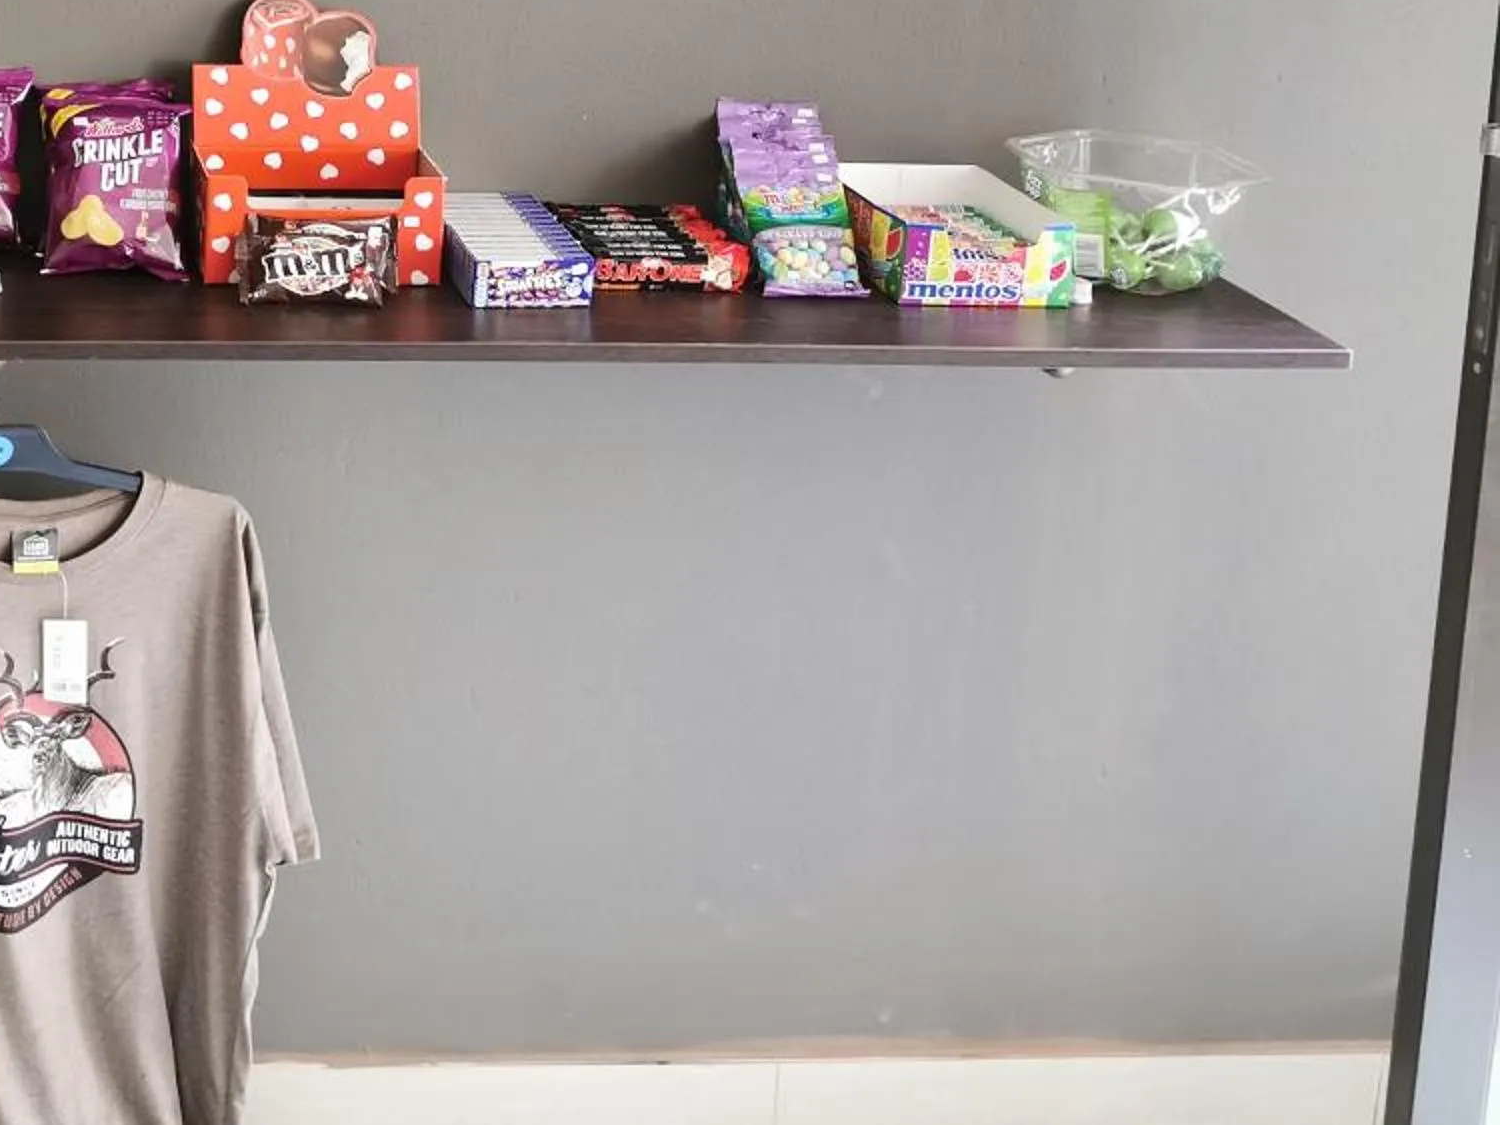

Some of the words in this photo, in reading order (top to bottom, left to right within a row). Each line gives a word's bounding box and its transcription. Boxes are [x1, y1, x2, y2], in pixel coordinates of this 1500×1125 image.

[71, 128, 165, 168] CRINKLE
[100, 158, 144, 192] CUT
[907, 282, 1020, 299] mentos
[55, 821, 132, 847] AUTHENTIC
[102, 846, 136, 864] GEAR
